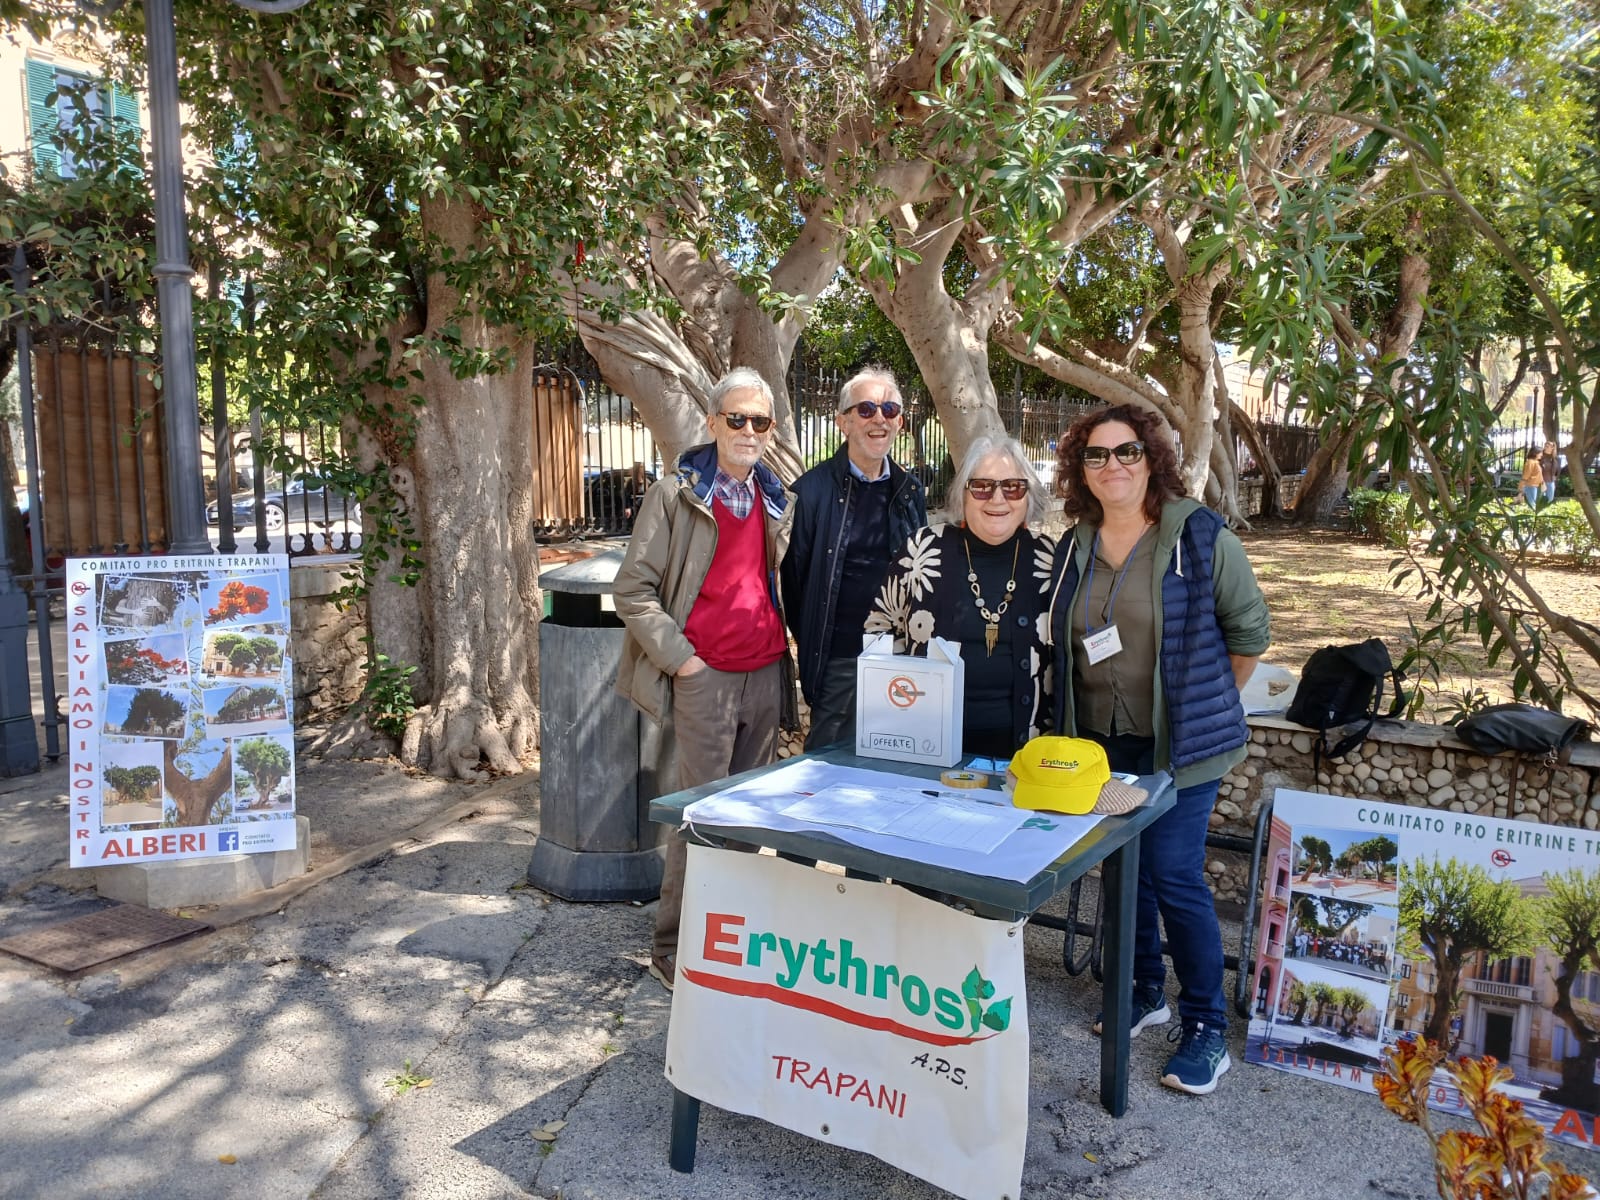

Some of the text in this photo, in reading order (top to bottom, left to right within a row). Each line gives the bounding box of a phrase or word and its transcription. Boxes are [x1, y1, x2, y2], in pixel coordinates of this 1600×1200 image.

[81, 557, 276, 571] COMITATO PRO ERITRINE TRAPANI
[71, 605, 93, 730] SALVIAMO
[873, 738, 911, 749] OFFERTE
[1041, 758, 1074, 767] Erythros
[73, 762, 93, 856] NOSTRI
[101, 832, 206, 859] ALBERI
[1358, 808, 1445, 833] COMITATO
[1454, 822, 1486, 839] PRO
[1496, 827, 1576, 852] ERITRINE
[702, 912, 966, 1030] Erythros
[911, 1053, 969, 1090] A.P.S.
[1263, 1043, 1362, 1083] SALVIAM
[772, 1055, 907, 1119] TRAPANI
